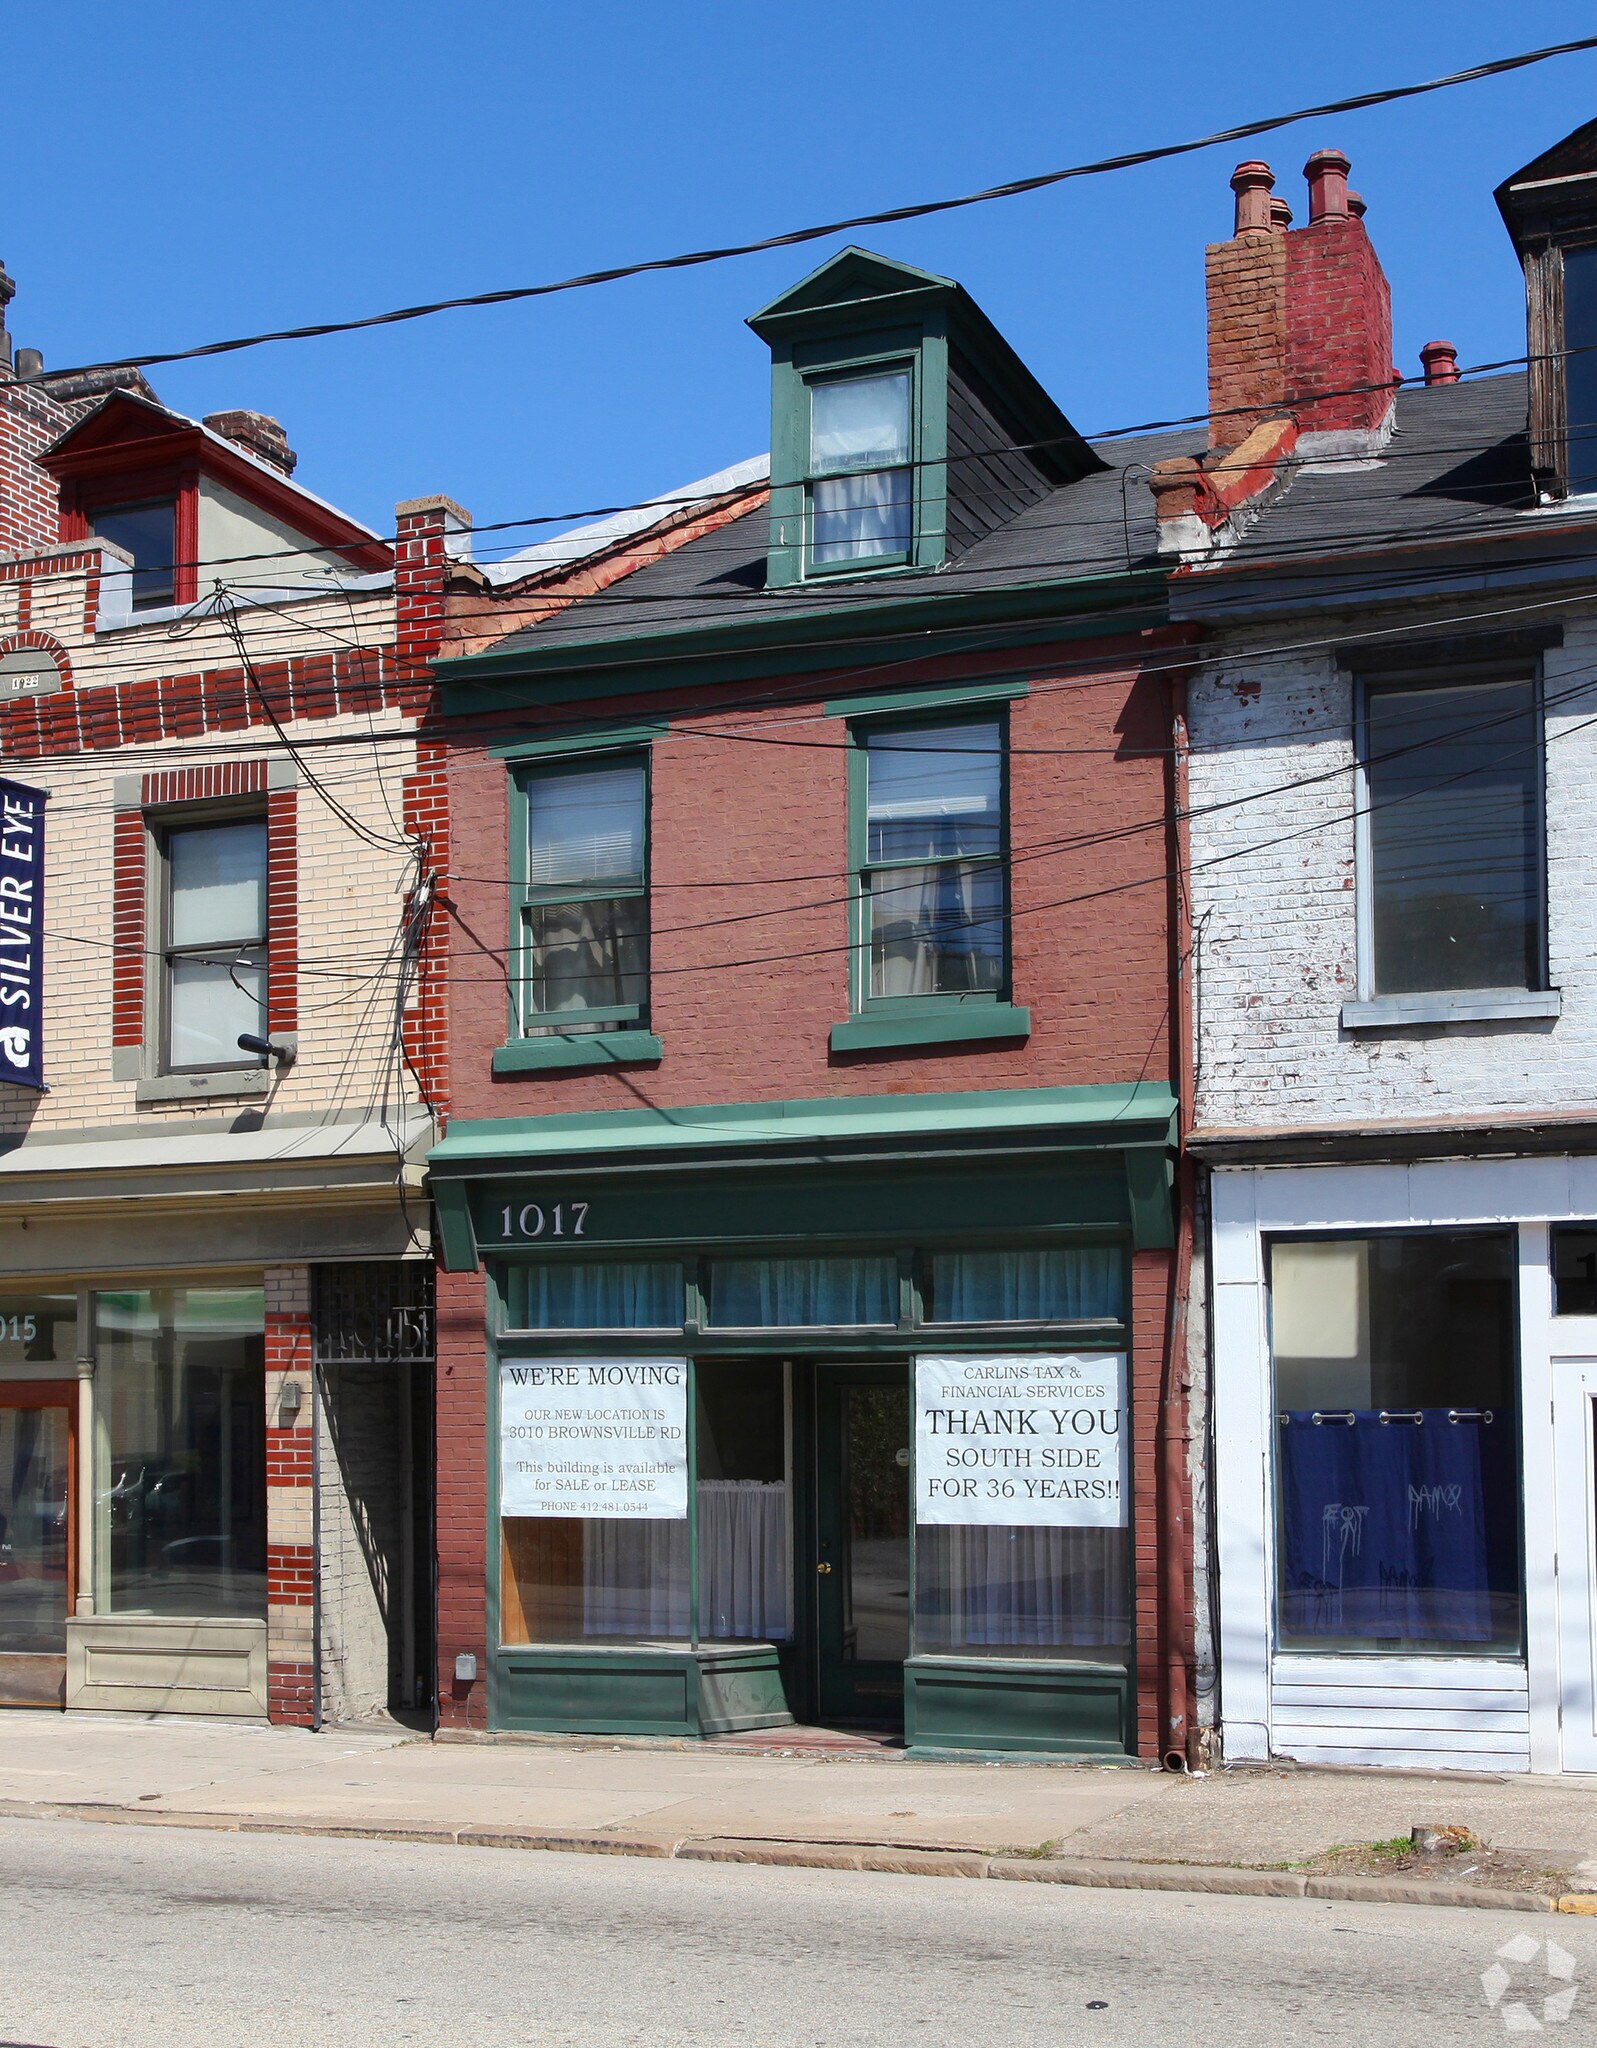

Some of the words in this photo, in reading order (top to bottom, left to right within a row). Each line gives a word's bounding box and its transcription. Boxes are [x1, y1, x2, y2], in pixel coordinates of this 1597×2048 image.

[1, 795, 33, 862] EYE
[0, 876, 33, 1010] SILVER
[502, 1202, 588, 1237] 1017
[509, 1367, 580, 1385] WE'RE
[588, 1366, 681, 1385] MOVING
[964, 1366, 1029, 1379] CARLINS
[1034, 1366, 1064, 1379] TAX
[1069, 1366, 1082, 1379] &
[941, 1386, 1021, 1398] FINANCIAL
[1026, 1385, 1105, 1398] SERVICES
[524, 1409, 551, 1420] OUR
[555, 1409, 583, 1420] NEW
[587, 1409, 650, 1420] LOCATION
[653, 1409, 666, 1420] IS
[925, 1409, 1039, 1435] THANK
[1050, 1409, 1121, 1435] YOU
[509, 1426, 543, 1439] 3010
[548, 1426, 656, 1439] BROWNSVILLE
[660, 1427, 681, 1439] RD
[946, 1448, 1031, 1468] SOUTH
[1041, 1448, 1101, 1468] SIDE
[516, 1461, 543, 1473] This
[547, 1461, 599, 1476] building
[603, 1462, 614, 1474] is
[618, 1461, 676, 1474] available
[535, 1479, 551, 1490] for
[555, 1480, 590, 1491] SALE
[594, 1483, 607, 1491] or
[612, 1480, 656, 1491] LEASE
[928, 1478, 978, 1497] FOR
[986, 1478, 1015, 1498] 36
[1023, 1479, 1120, 1499] YEARS!!
[541, 1502, 577, 1511] PHONE
